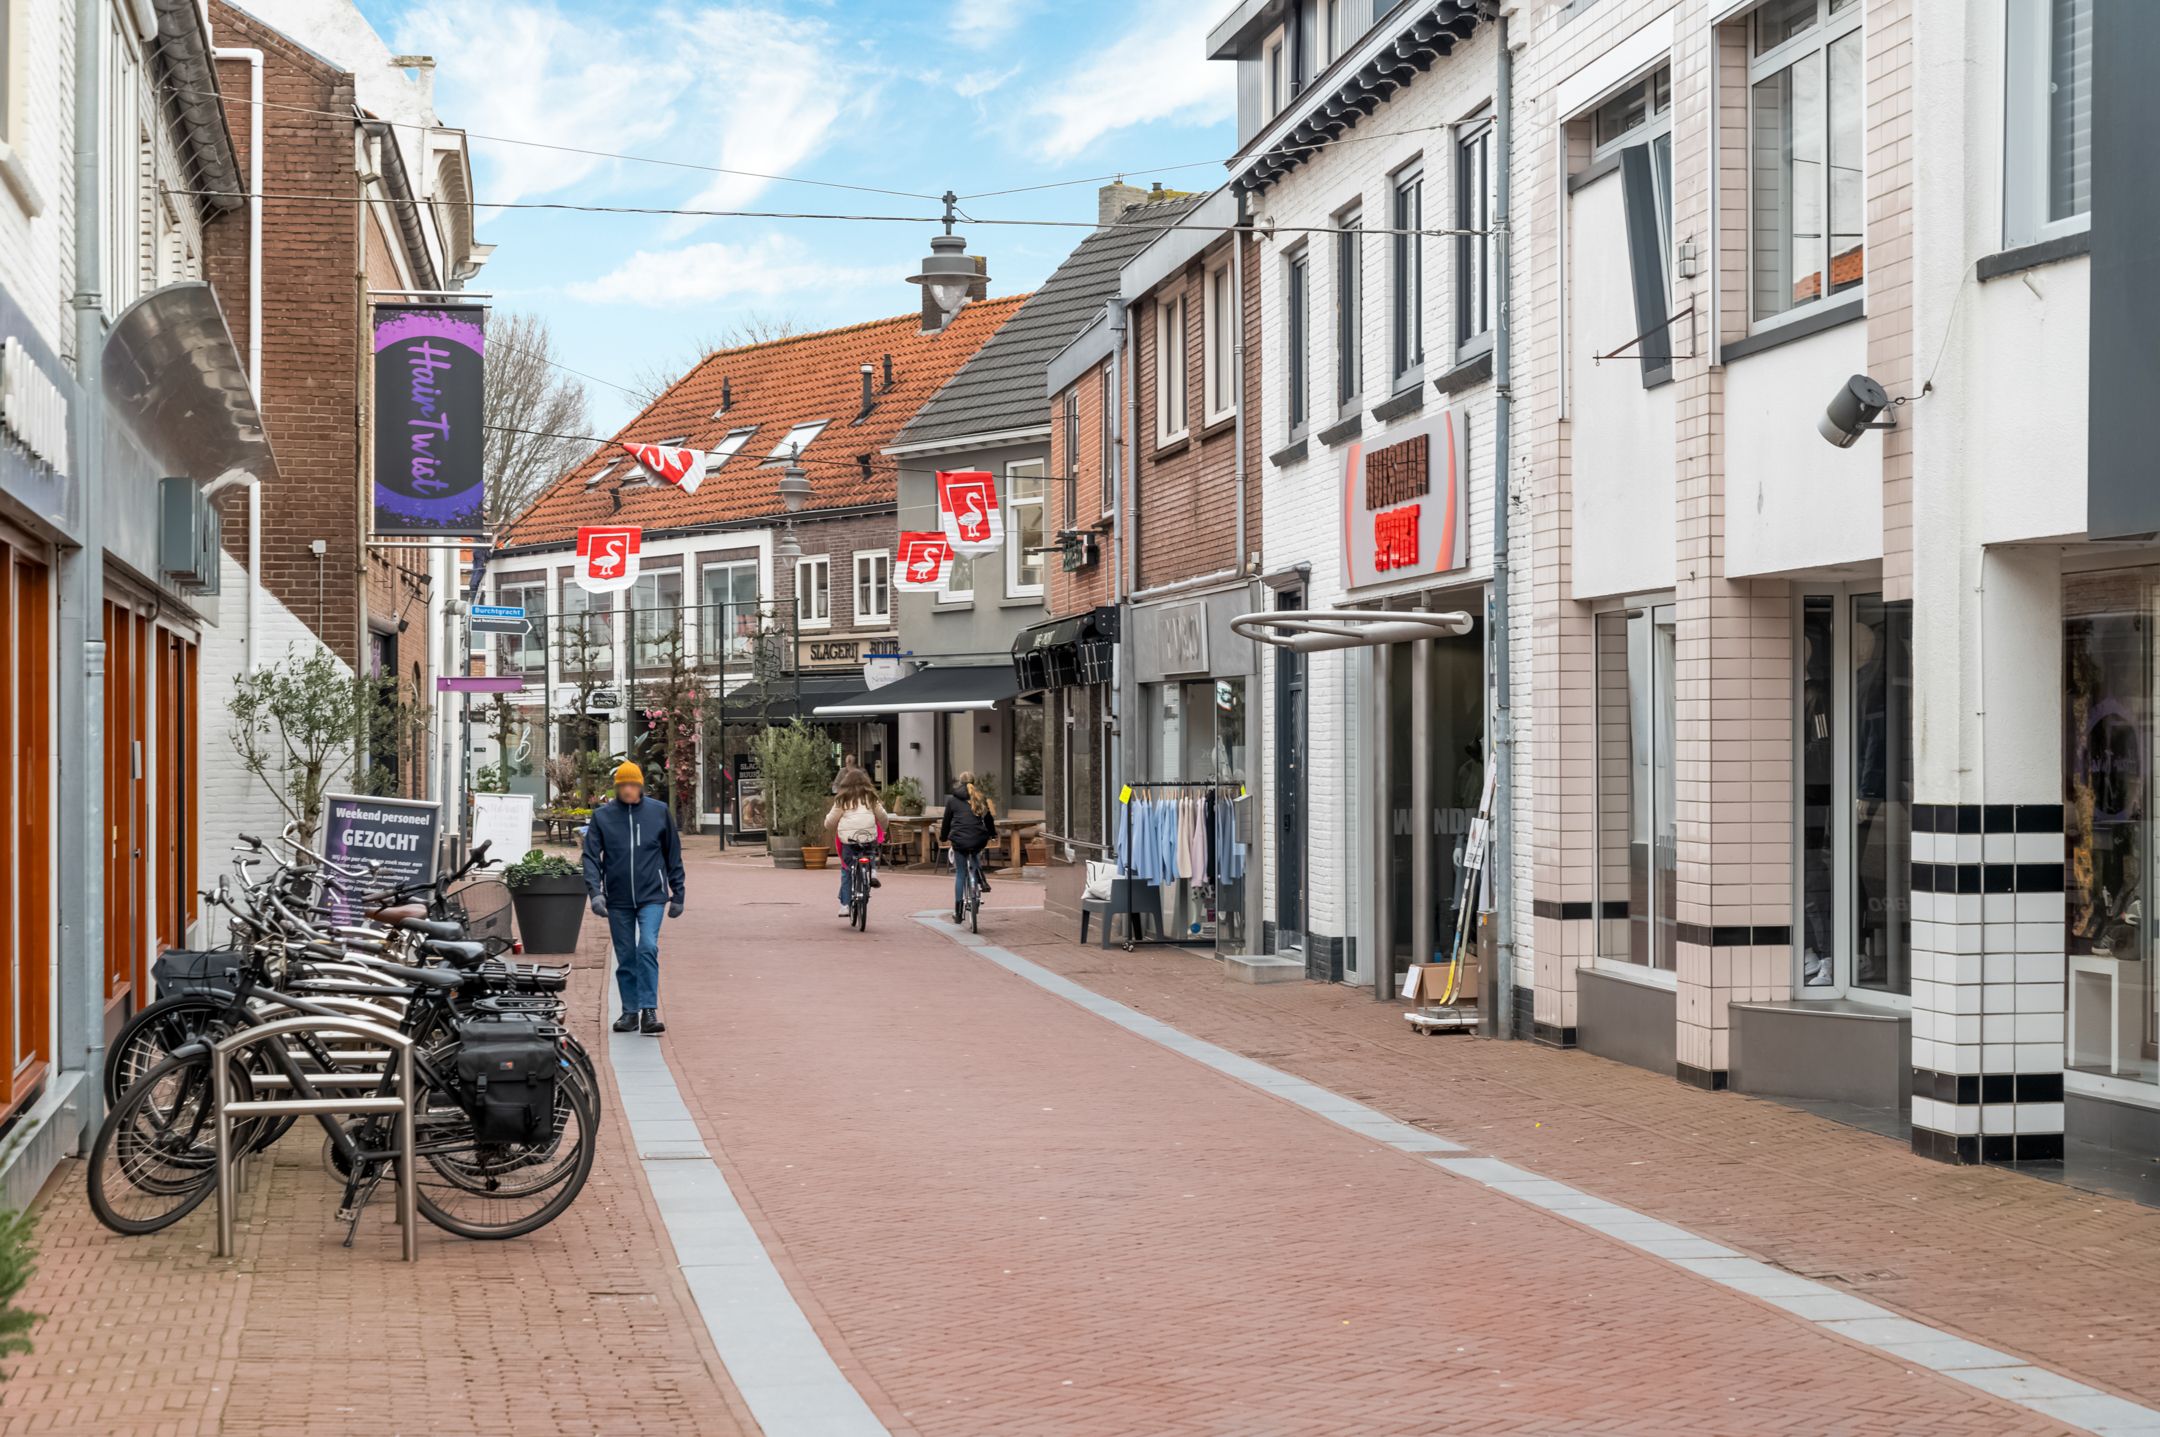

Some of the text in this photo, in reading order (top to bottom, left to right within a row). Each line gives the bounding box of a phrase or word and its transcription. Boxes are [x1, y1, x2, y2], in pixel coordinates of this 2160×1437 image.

[407, 340, 452, 495] Hair Twist
[474, 607, 521, 616] Burchtgracht
[810, 642, 859, 662] SLAGERIJ
[336, 807, 430, 825] Weekend personeel
[342, 829, 419, 851] GEZOCHT
